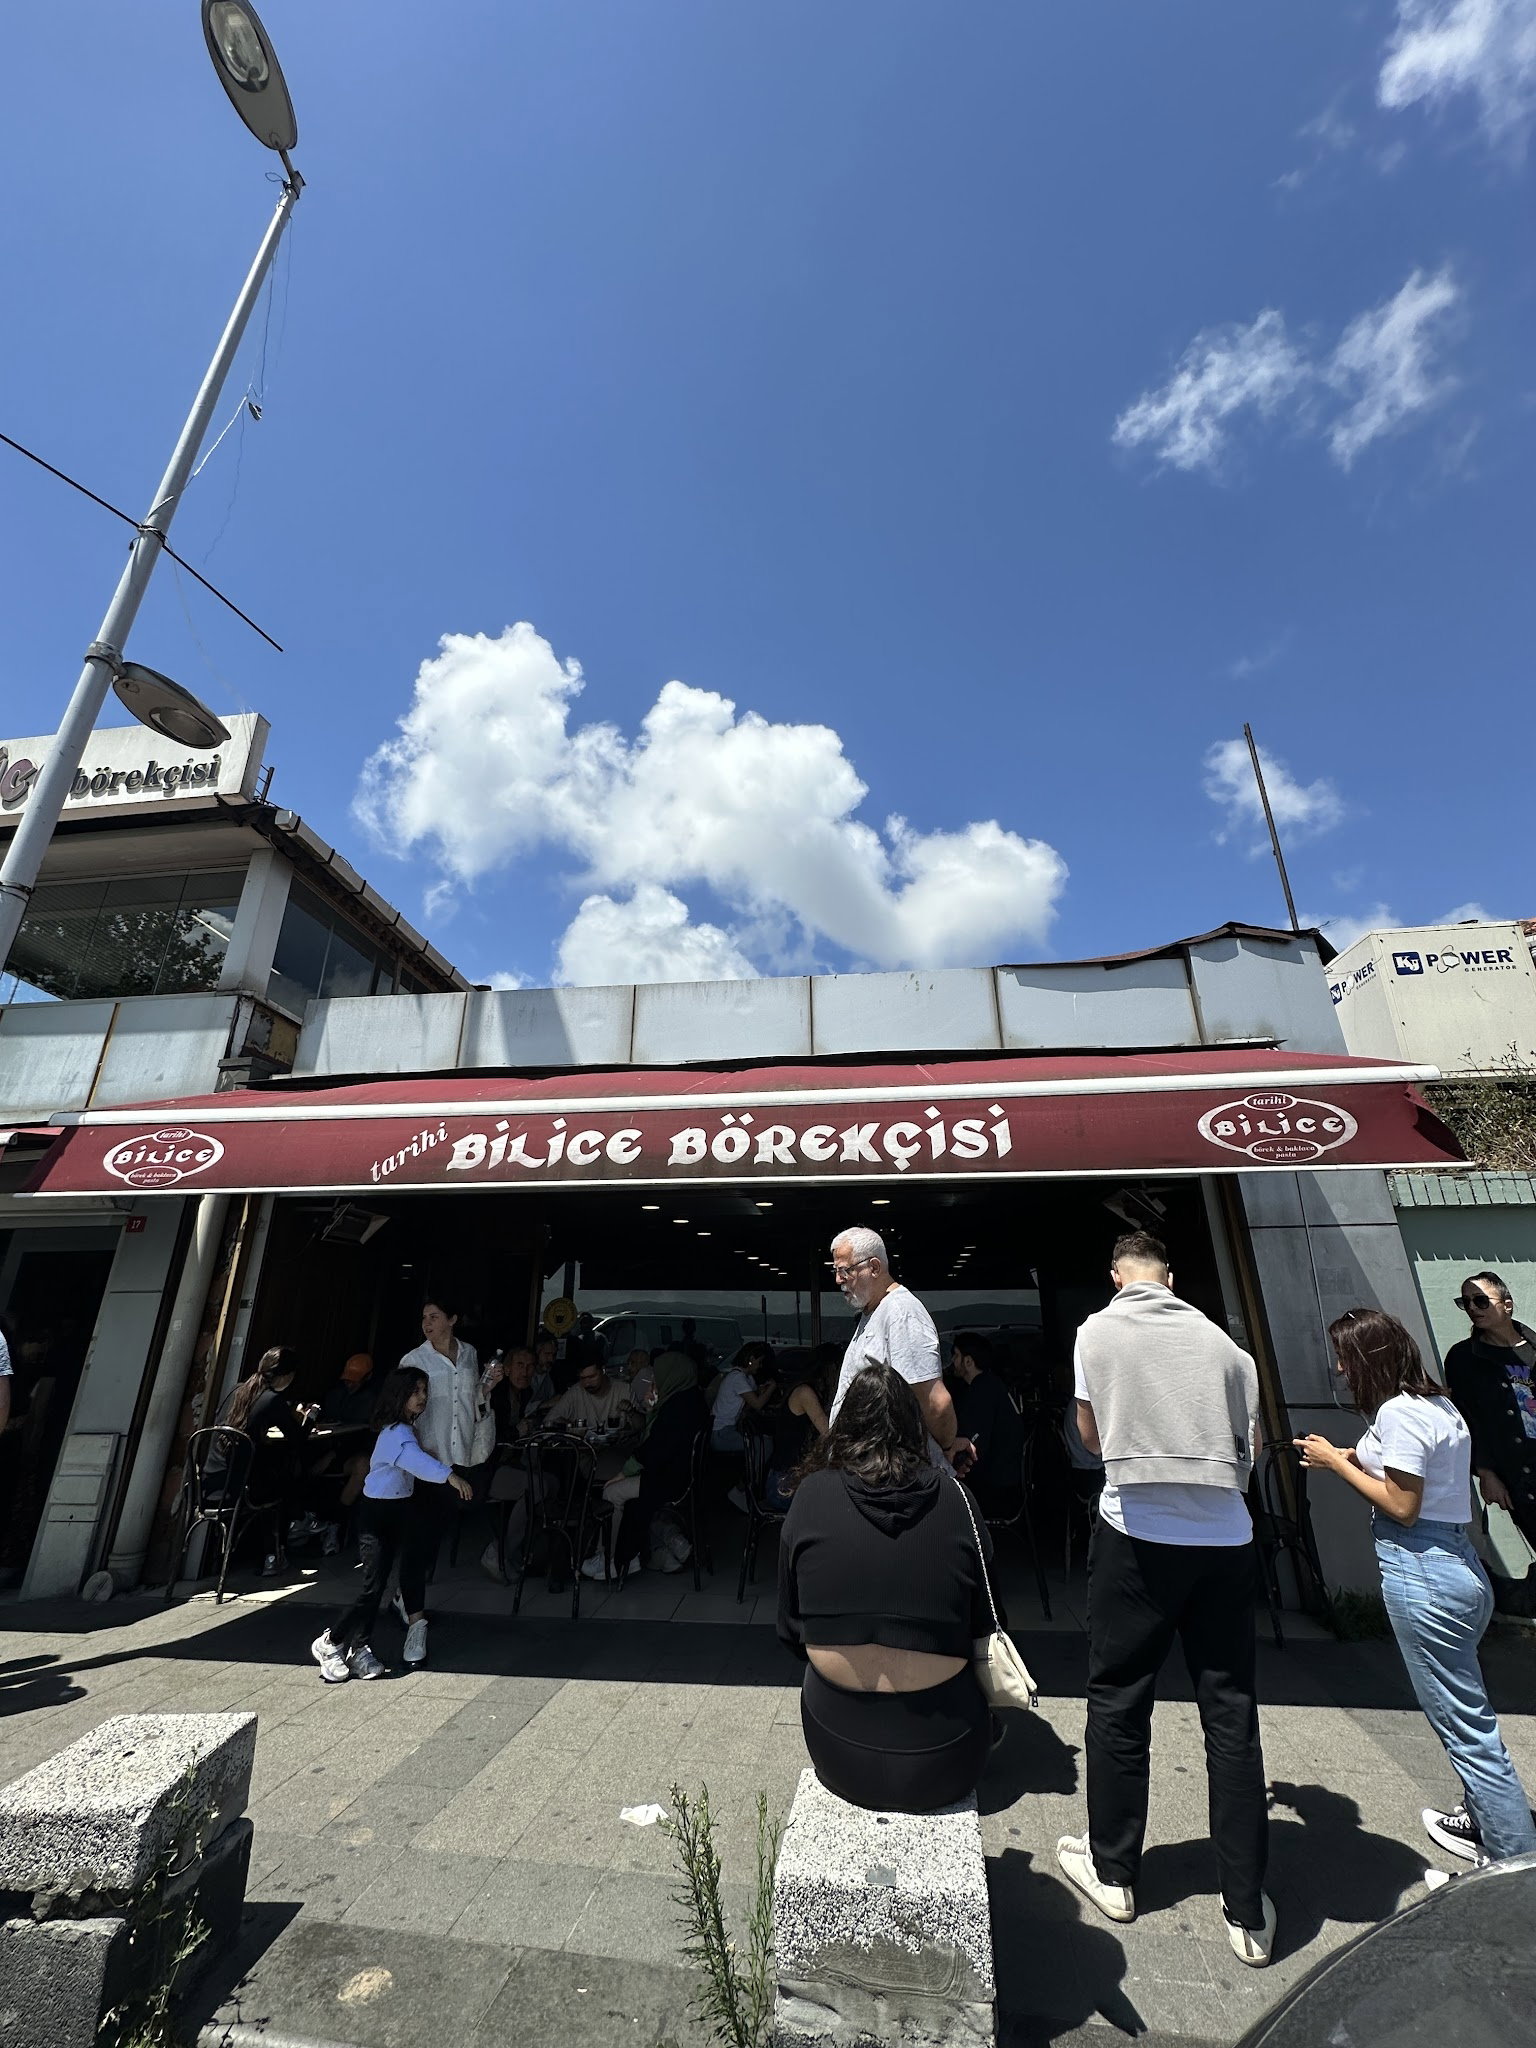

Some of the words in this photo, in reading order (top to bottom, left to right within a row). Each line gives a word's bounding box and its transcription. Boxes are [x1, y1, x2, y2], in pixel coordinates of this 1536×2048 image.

[71, 753, 221, 796] börekçisi
[1252, 1095, 1287, 1106] tarihi
[370, 1121, 449, 1182] tarihi
[131, 1219, 141, 1229] 17
